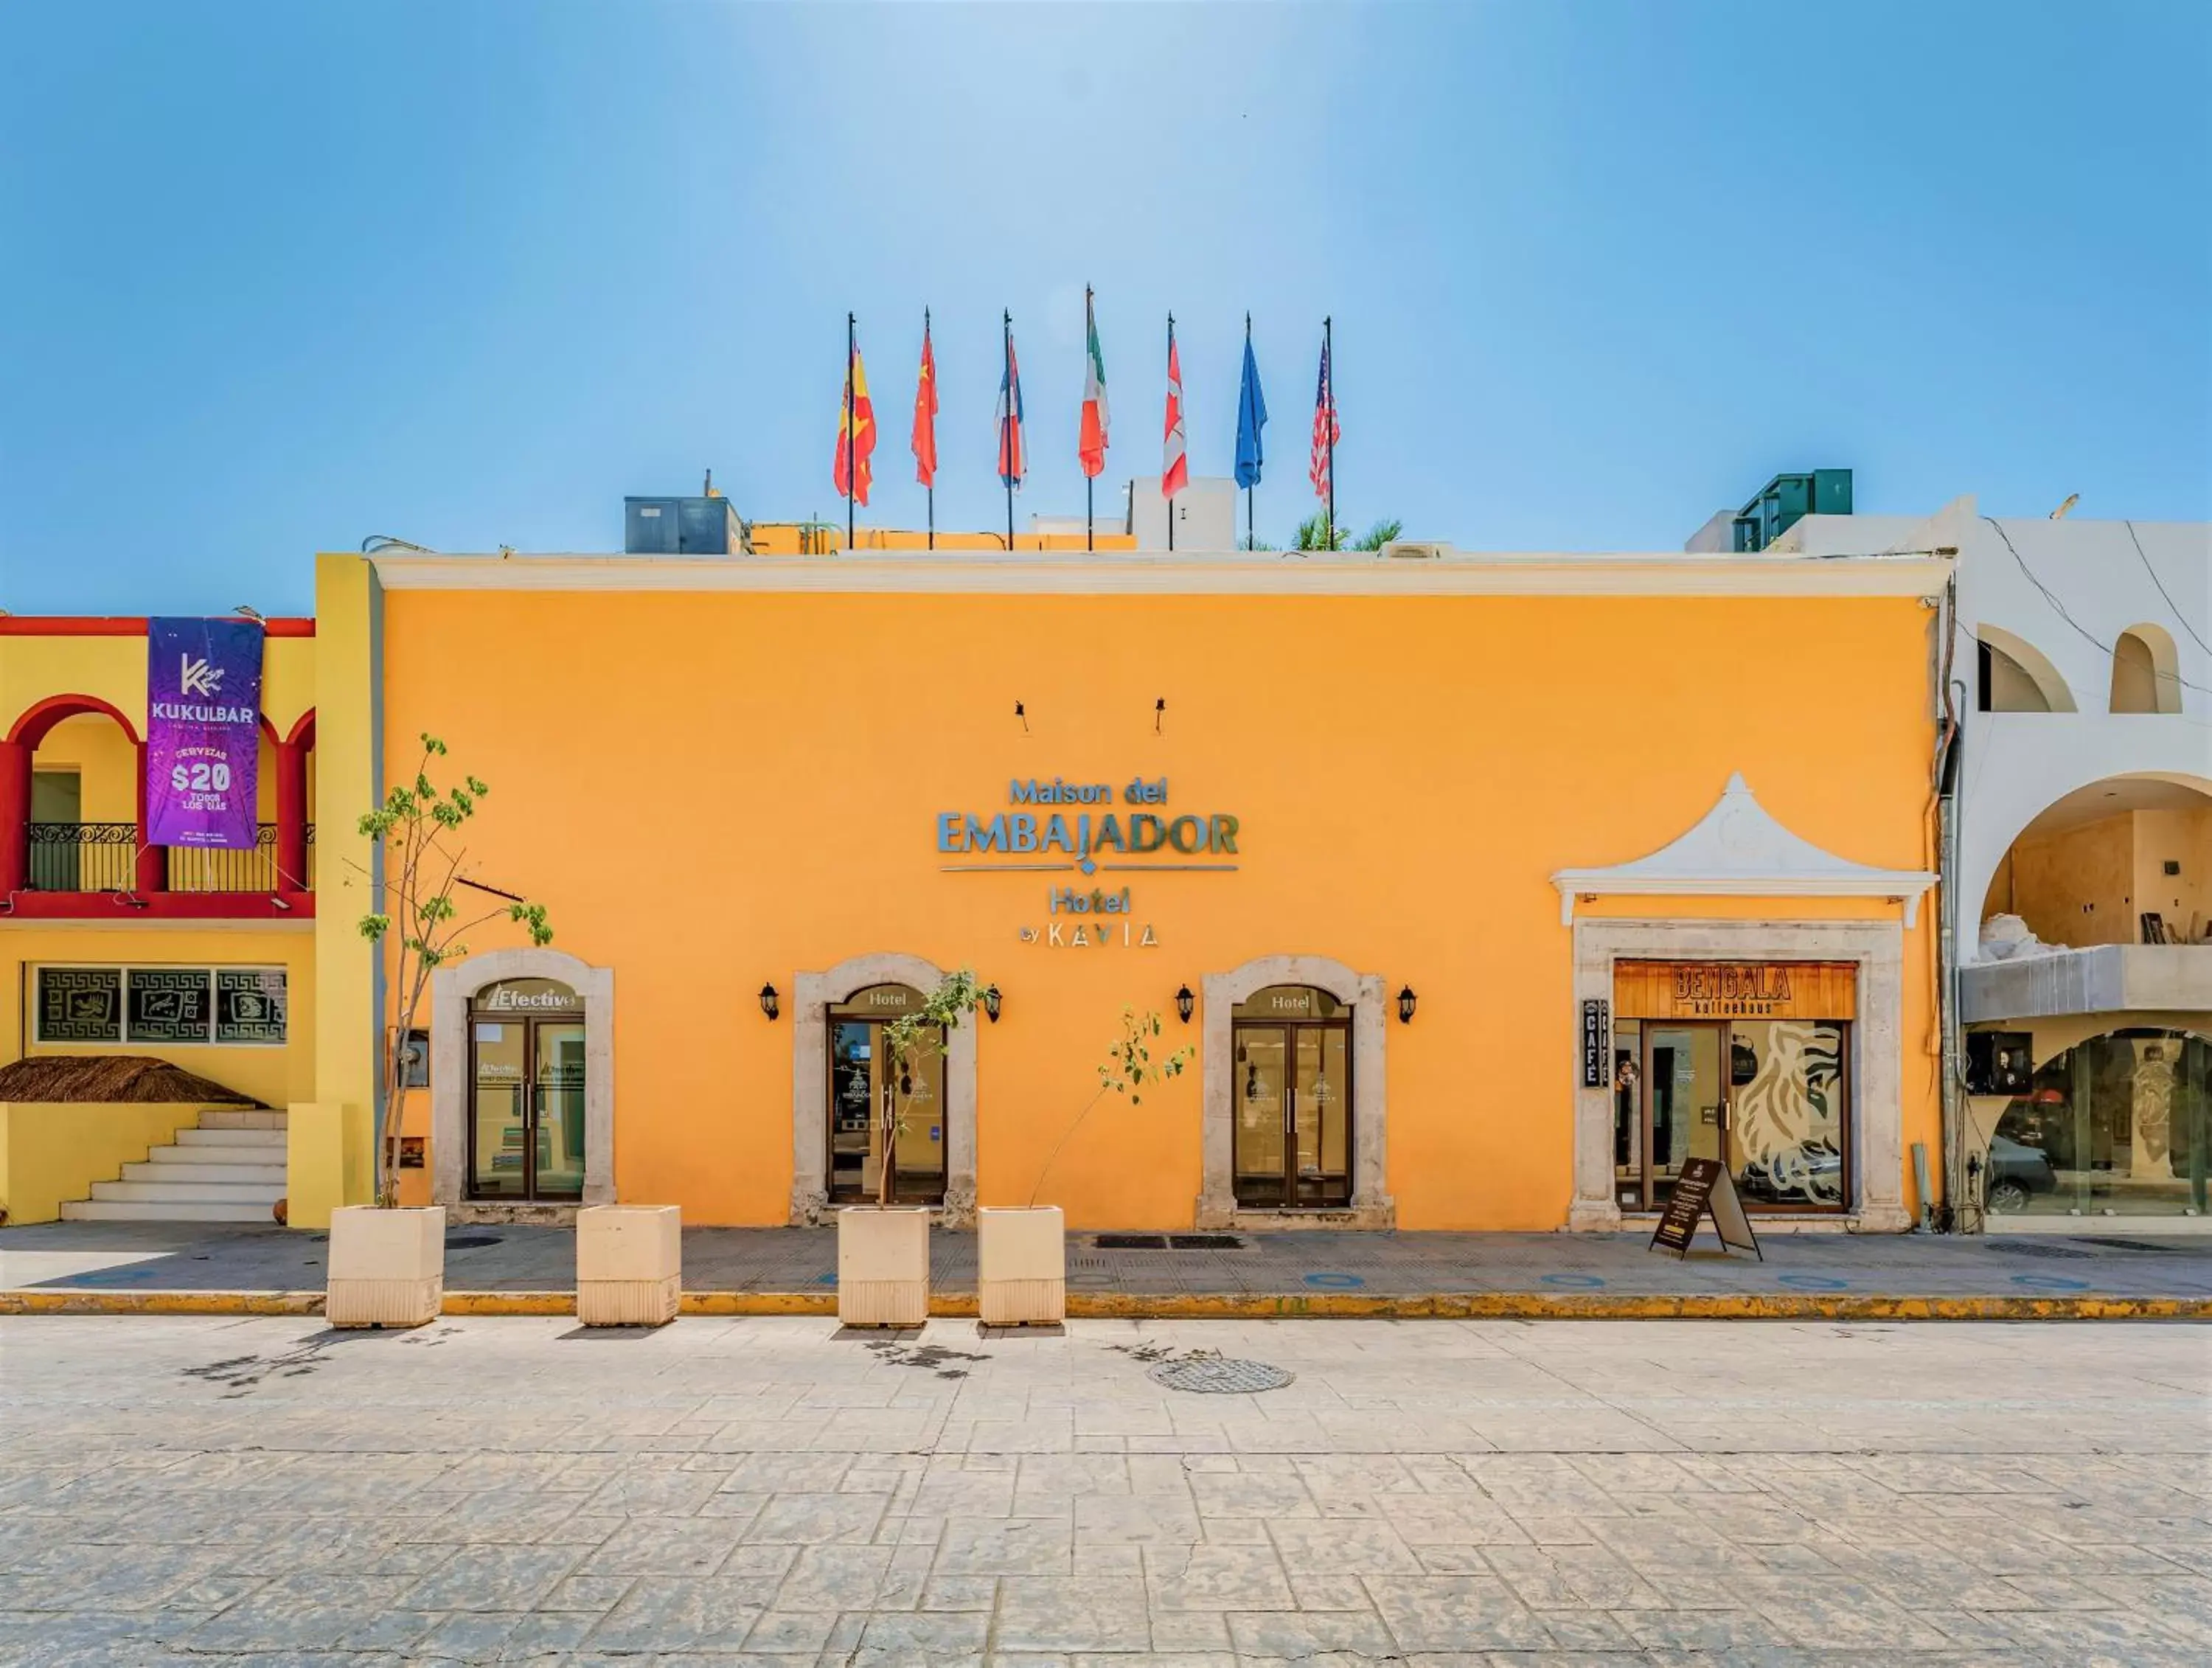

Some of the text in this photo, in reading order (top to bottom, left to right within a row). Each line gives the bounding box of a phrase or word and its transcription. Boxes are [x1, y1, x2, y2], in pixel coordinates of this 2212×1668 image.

[153, 703, 254, 723] KUKULBAR
[175, 747, 227, 760] CERVEZAS
[172, 763, 230, 791] $20
[1009, 776, 1167, 805] Maison del
[183, 801, 203, 810] LOS
[936, 813, 1239, 860] EMBAJADOR
[1049, 886, 1130, 914] Hotel
[1048, 922, 1158, 948] KAVIA
[1675, 967, 1791, 999] BENGALA
[870, 993, 906, 1005] Hotel
[1273, 995, 1309, 1009] Hotel
